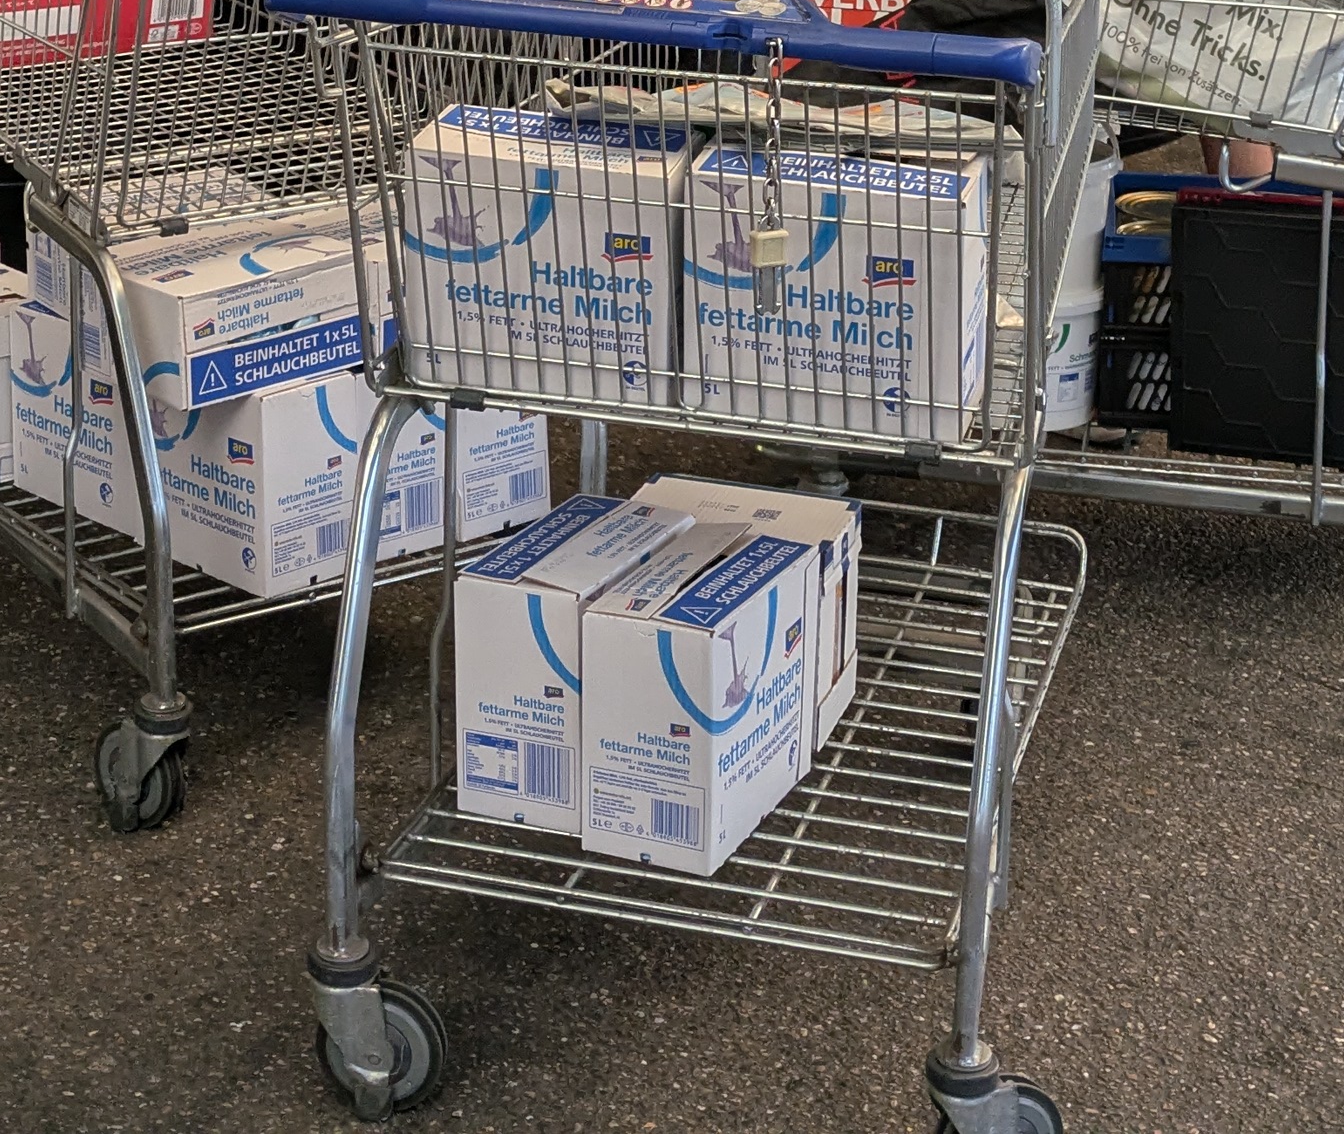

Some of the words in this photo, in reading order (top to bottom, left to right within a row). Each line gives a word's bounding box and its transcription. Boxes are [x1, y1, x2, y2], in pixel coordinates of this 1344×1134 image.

[1190, 18, 1266, 82] Tricks.
[1141, 49, 1162, 66] frei
[1164, 60, 1186, 77] von
[1188, 70, 1243, 108] Zusätzen.
[531, 260, 653, 297] Haltbare
[217, 302, 251, 322] Milch
[253, 287, 305, 310] fettarme
[445, 279, 564, 316] fettarme
[575, 296, 652, 326] Milch
[787, 284, 914, 322] Haltbare
[218, 312, 270, 335] Haltbare
[699, 302, 822, 340] fettarme
[832, 319, 914, 351] Mich
[235, 333, 320, 368] BEINHALTET
[744, 339, 773, 353] FETT
[763, 354, 779, 366] IM
[235, 341, 361, 386] SCHLAUCHBEUTEL
[93, 381, 109, 395] aro
[54, 395, 113, 432] Habare
[15, 403, 71, 439] fettarme
[77, 429, 113, 456] Milch
[469, 440, 508, 456] fettarme
[510, 431, 535, 445] Milch
[496, 422, 535, 439] Haltbare
[232, 441, 249, 456] aro
[397, 446, 436, 463] Haltbare
[411, 457, 436, 469] Milch
[190, 454, 256, 495] Haltbare
[304, 469, 343, 487] Haltbare
[214, 485, 256, 519] Milch
[277, 488, 316, 507] fettarme
[318, 479, 343, 494] Milch
[191, 502, 256, 534] ULTRAHOCHERHITZT
[199, 515, 256, 545] SCHLAUCHBEUTEL
[695, 549, 756, 599] BEINHALTET
[715, 543, 800, 605] SCHLAUCHBEUTEL
[756, 657, 802, 715] Haltbare
[478, 702, 529, 721] fettarme
[532, 711, 565, 727] Milch
[513, 695, 565, 714] Haltbare
[637, 732, 691, 753] Haltbare
[718, 719, 771, 777] fettarme
[773, 685, 801, 728] Milch
[600, 738, 653, 758] fettarme
[656, 749, 690, 766] Milch
[723, 771, 738, 791] 1,5%
[737, 764, 751, 779] FETT
